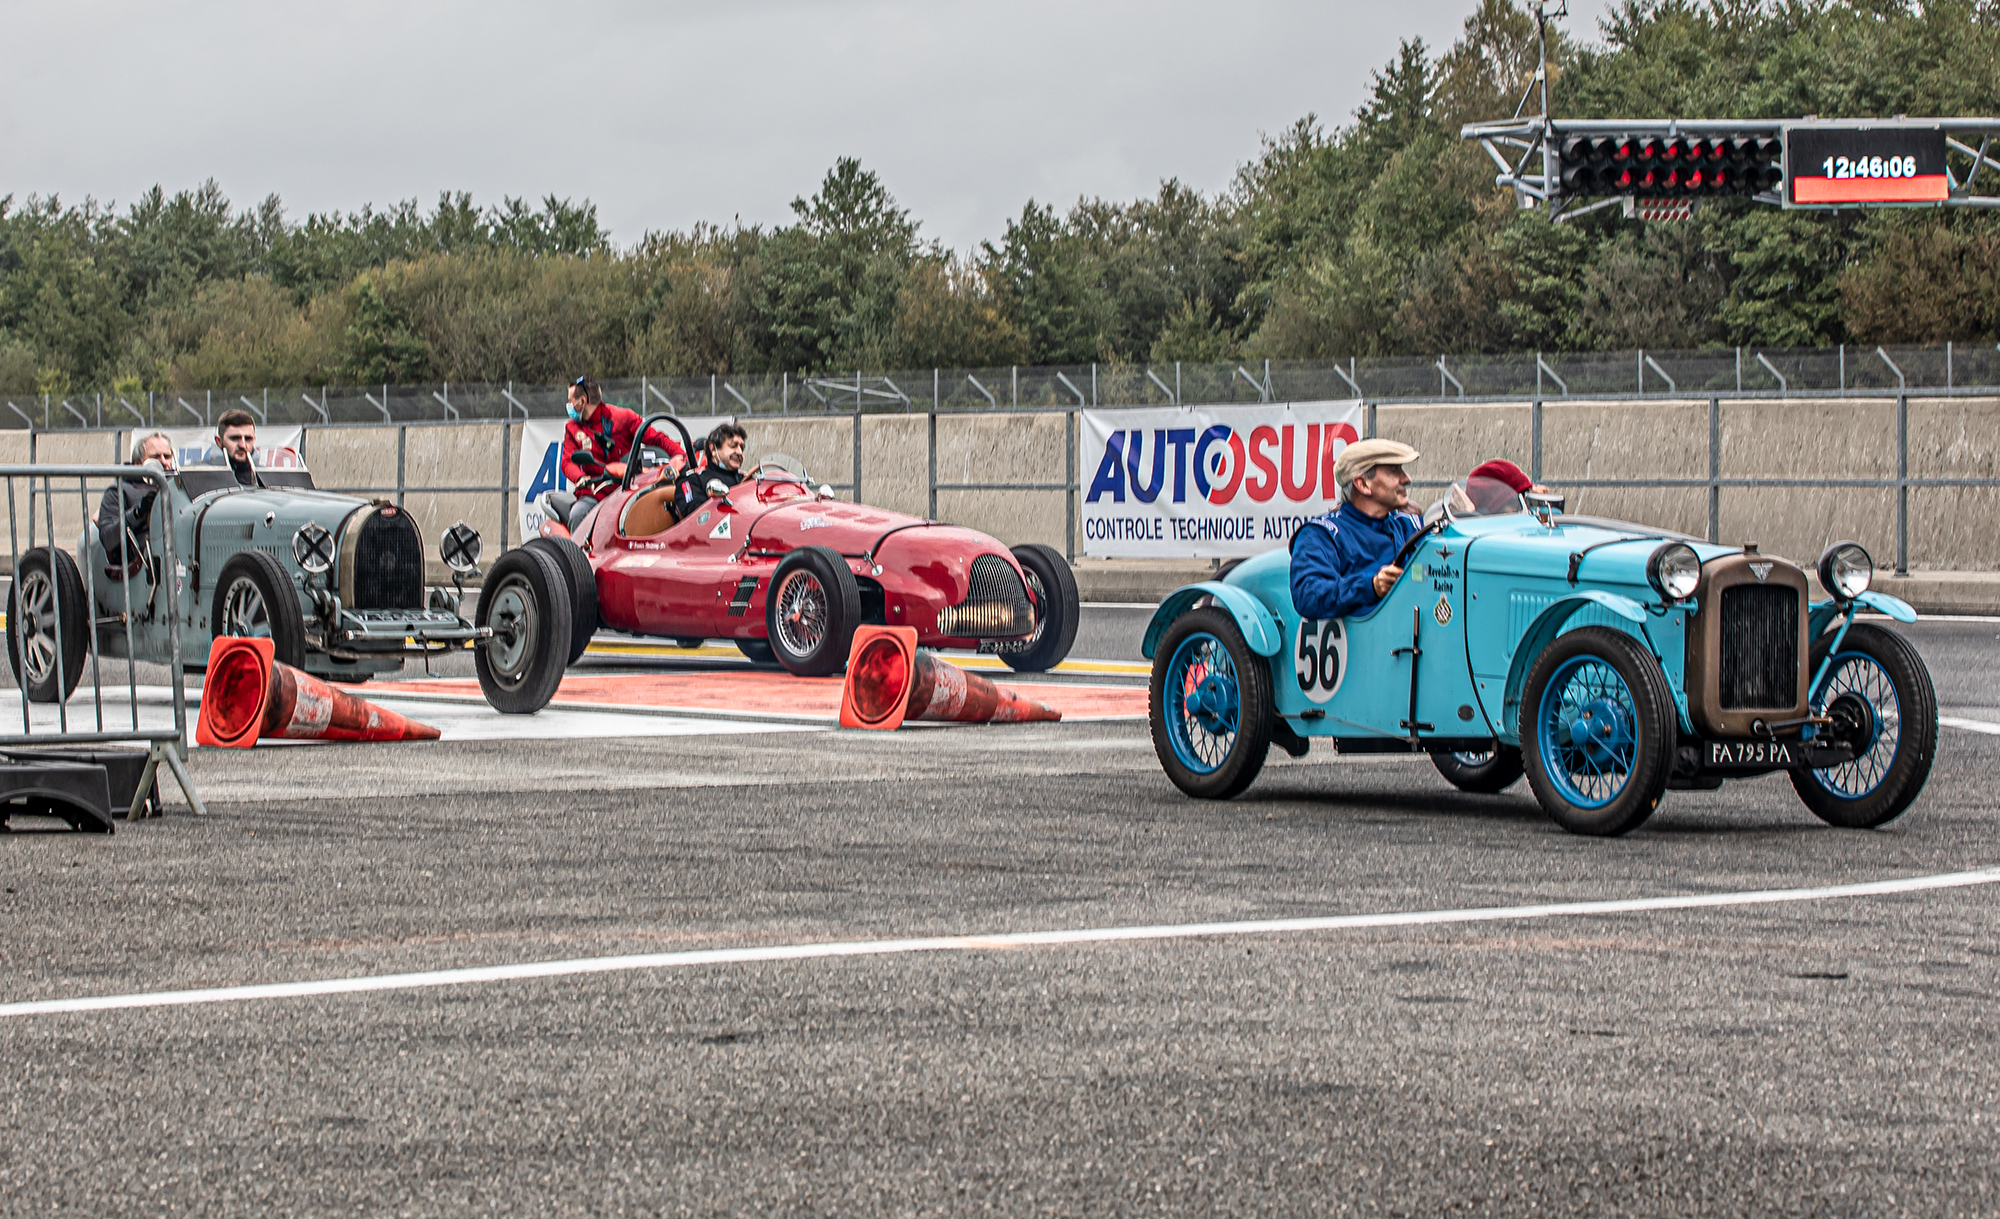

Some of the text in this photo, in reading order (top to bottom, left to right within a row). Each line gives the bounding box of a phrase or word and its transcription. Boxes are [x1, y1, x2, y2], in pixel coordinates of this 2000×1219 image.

[1822, 155, 1917, 179] 12:46:06
[1086, 518, 1163, 541] CONTROLE
[1170, 517, 1255, 541] TECHNIQUE
[1434, 579, 1454, 595] Racing
[1297, 619, 1342, 691] 56
[1712, 743, 1792, 763] FA 795 PA
